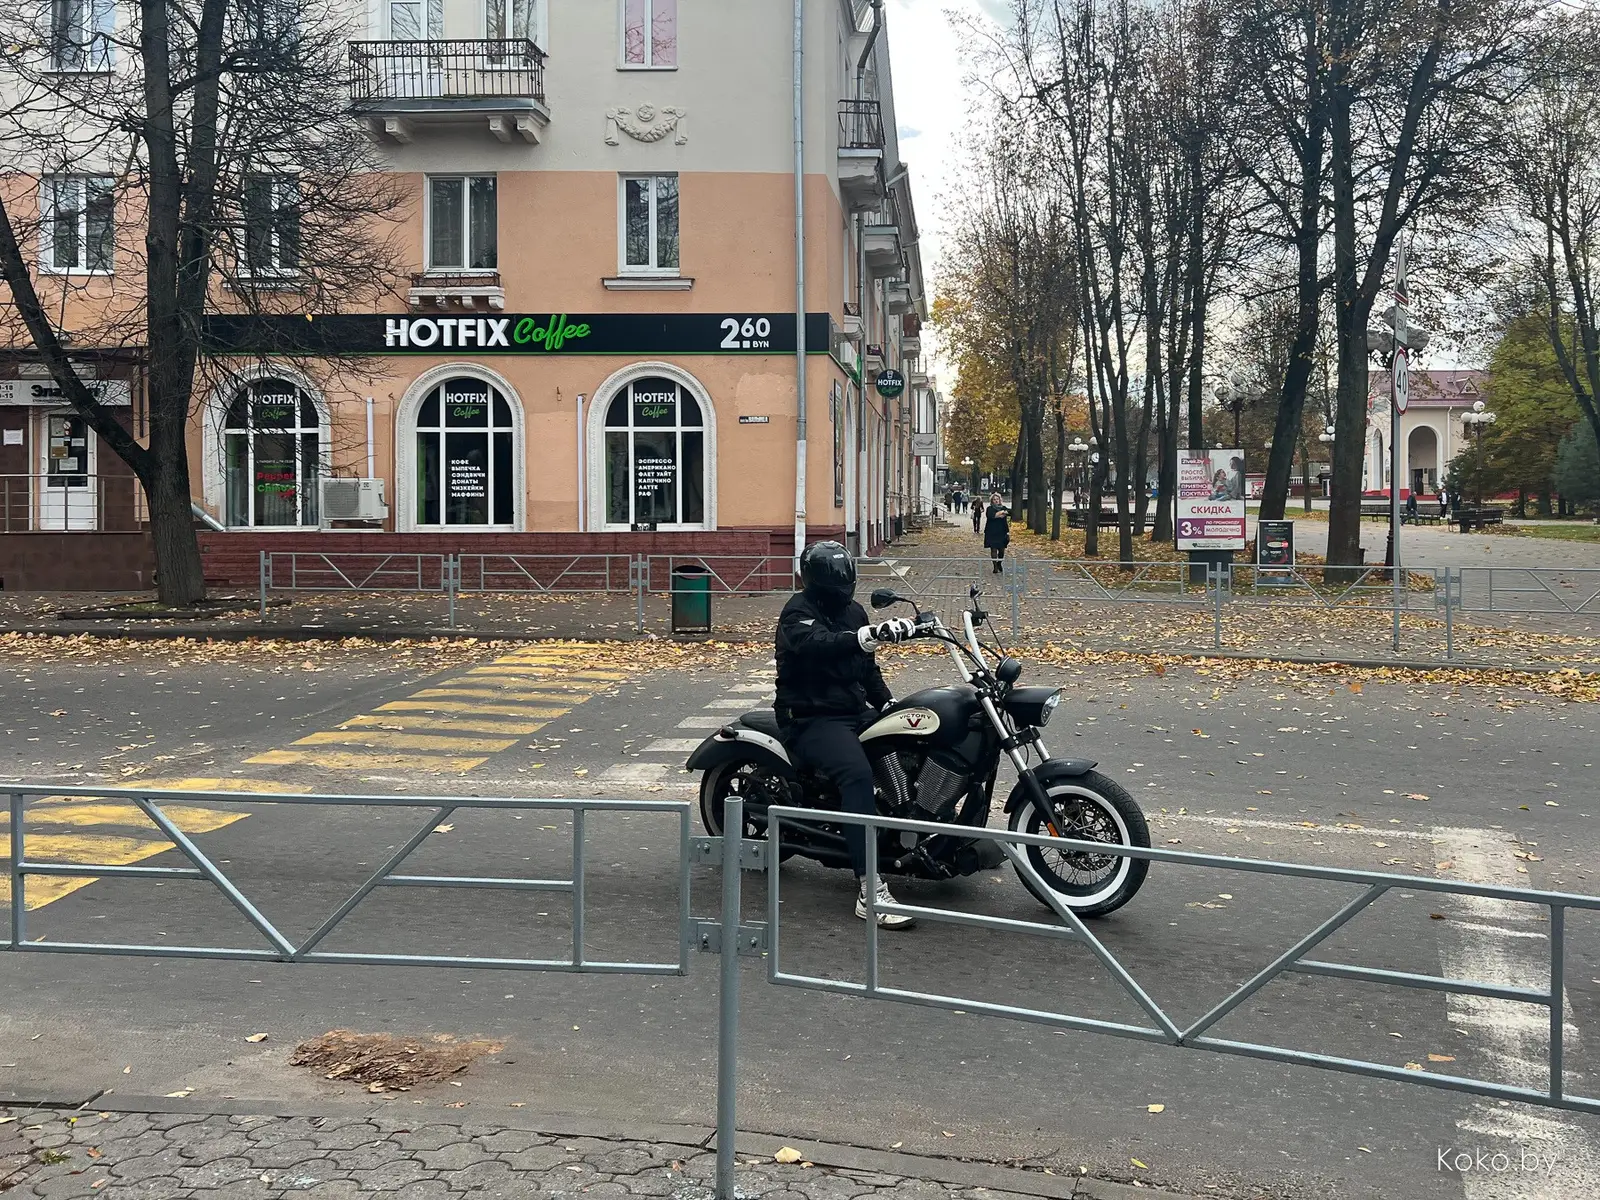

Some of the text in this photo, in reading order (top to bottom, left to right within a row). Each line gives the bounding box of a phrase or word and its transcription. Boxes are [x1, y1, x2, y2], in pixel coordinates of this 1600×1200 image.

[385, 313, 591, 350] HOTFIX Coffee
[752, 340, 769, 348] BYN
[1396, 370, 1407, 395] 40
[446, 393, 487, 403] HOTFIX
[634, 392, 675, 403] HOTFIX
[453, 406, 481, 419] Coffee
[641, 406, 669, 418] Coffee
[1190, 506, 1232, 515] СКИДКА
[1181, 521, 1203, 536] 3%
